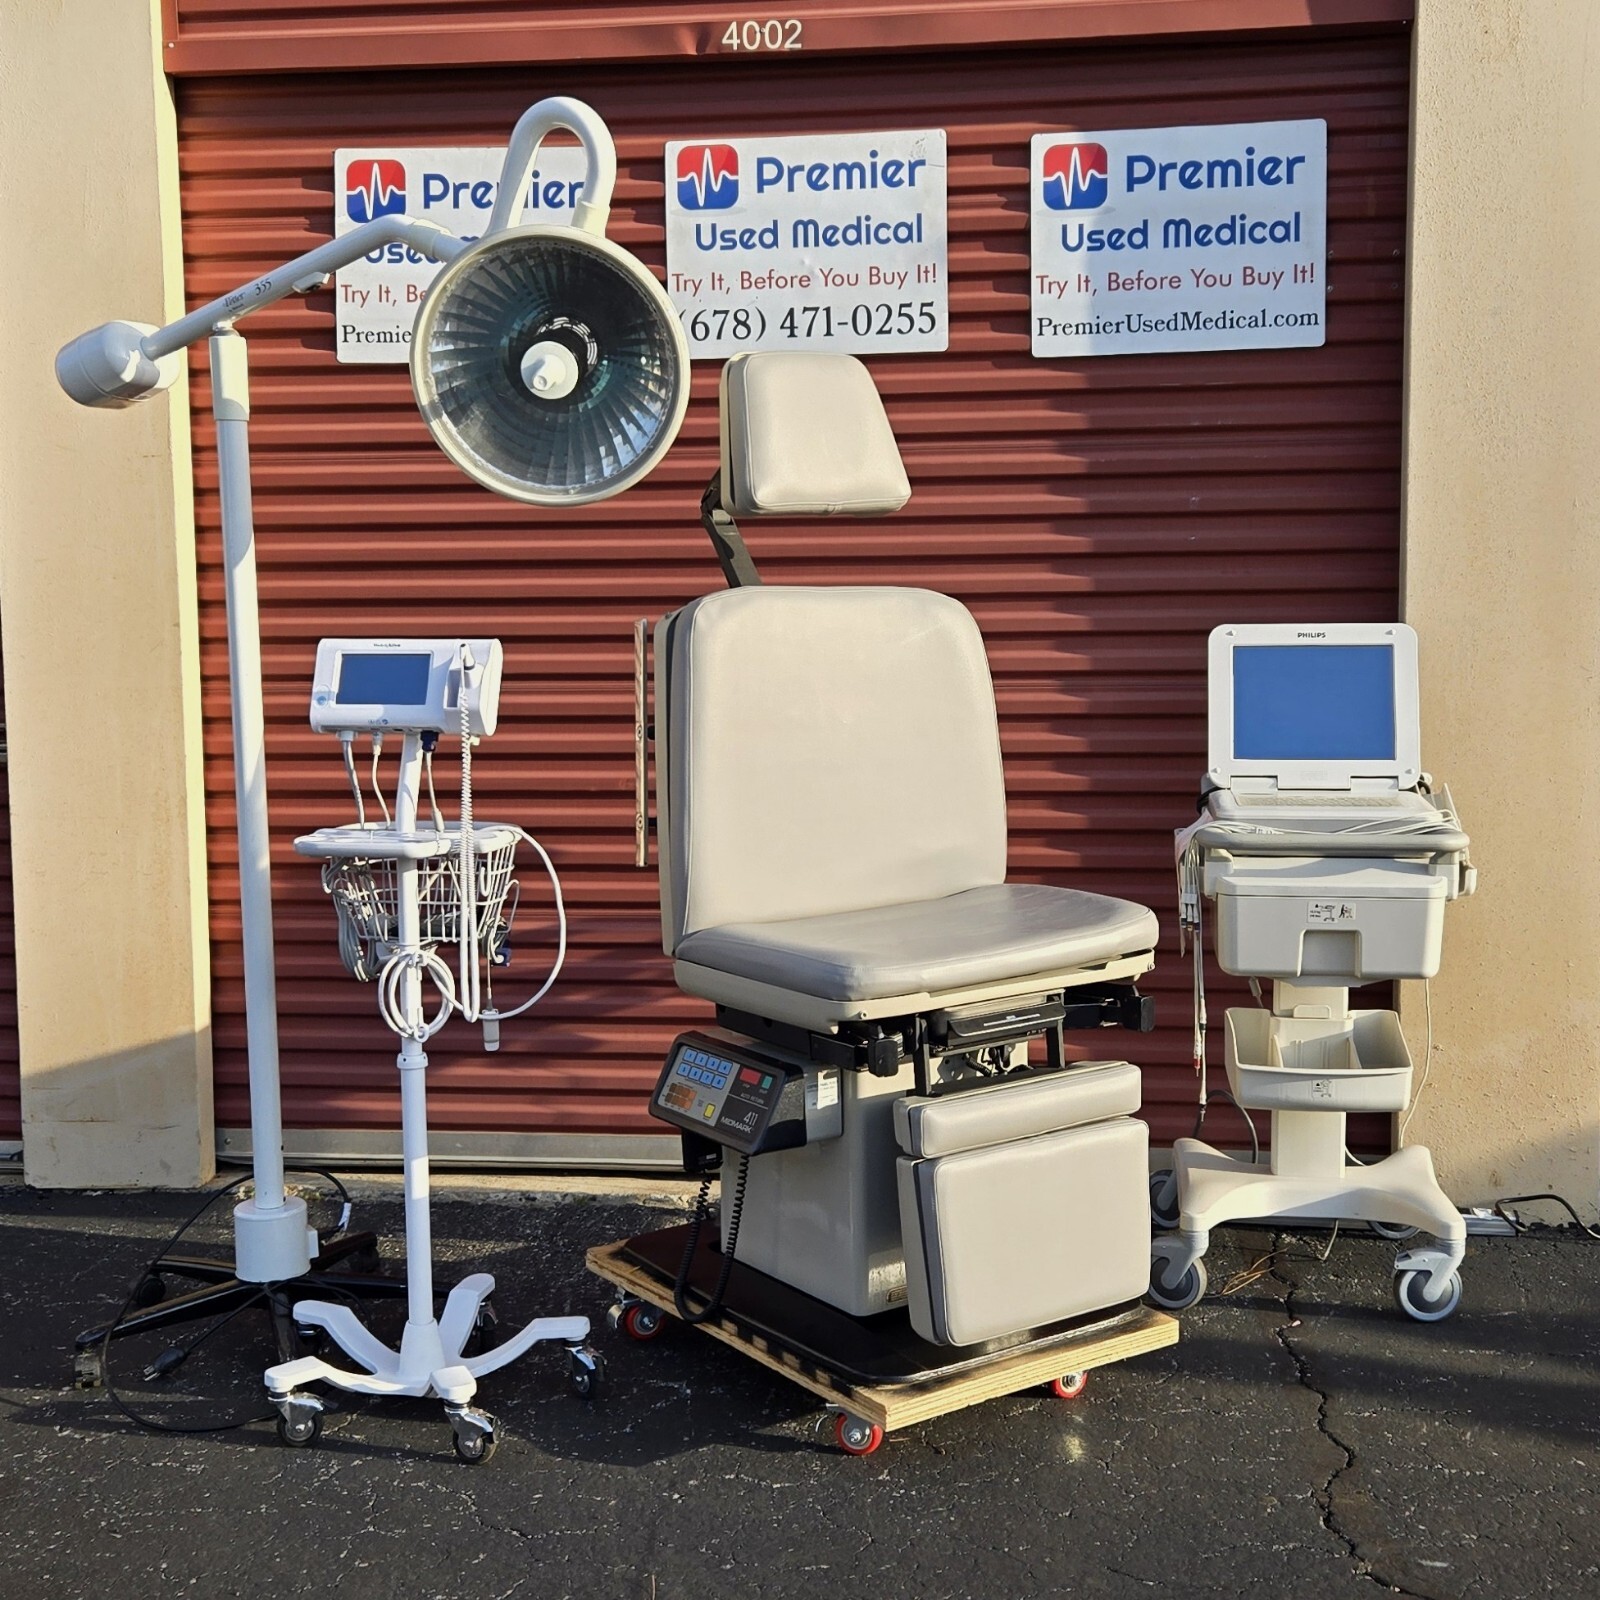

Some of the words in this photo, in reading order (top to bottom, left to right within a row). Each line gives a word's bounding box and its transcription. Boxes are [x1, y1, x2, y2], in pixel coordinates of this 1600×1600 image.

[721, 19, 803, 51] 4002
[756, 149, 927, 194] Premier
[1126, 146, 1306, 193] Premier
[423, 169, 585, 210] Preier
[695, 219, 779, 251] Used
[792, 212, 923, 249] Medical
[1061, 218, 1149, 252] Used
[1163, 211, 1301, 249] Medical
[340, 283, 371, 309] Try
[378, 283, 397, 307] It,
[672, 273, 703, 297] Try
[711, 271, 731, 295] It,
[740, 268, 811, 291] Before
[819, 267, 859, 288] You
[869, 265, 909, 290] Buy
[917, 262, 937, 284] It!
[1036, 274, 1068, 299] Try
[1077, 273, 1097, 297] It,
[1107, 269, 1182, 292] Before
[1190, 267, 1233, 289] You
[1242, 265, 1285, 291] Buy
[1293, 262, 1315, 284] It!
[779, 300, 937, 339] 471-0255
[1036, 308, 1320, 337] PremierUsedMedical.com
[1297, 631, 1327, 639] PHILIPS
[720, 1116, 753, 1134] MIDMARK
[743, 1111, 759, 1126] 411
